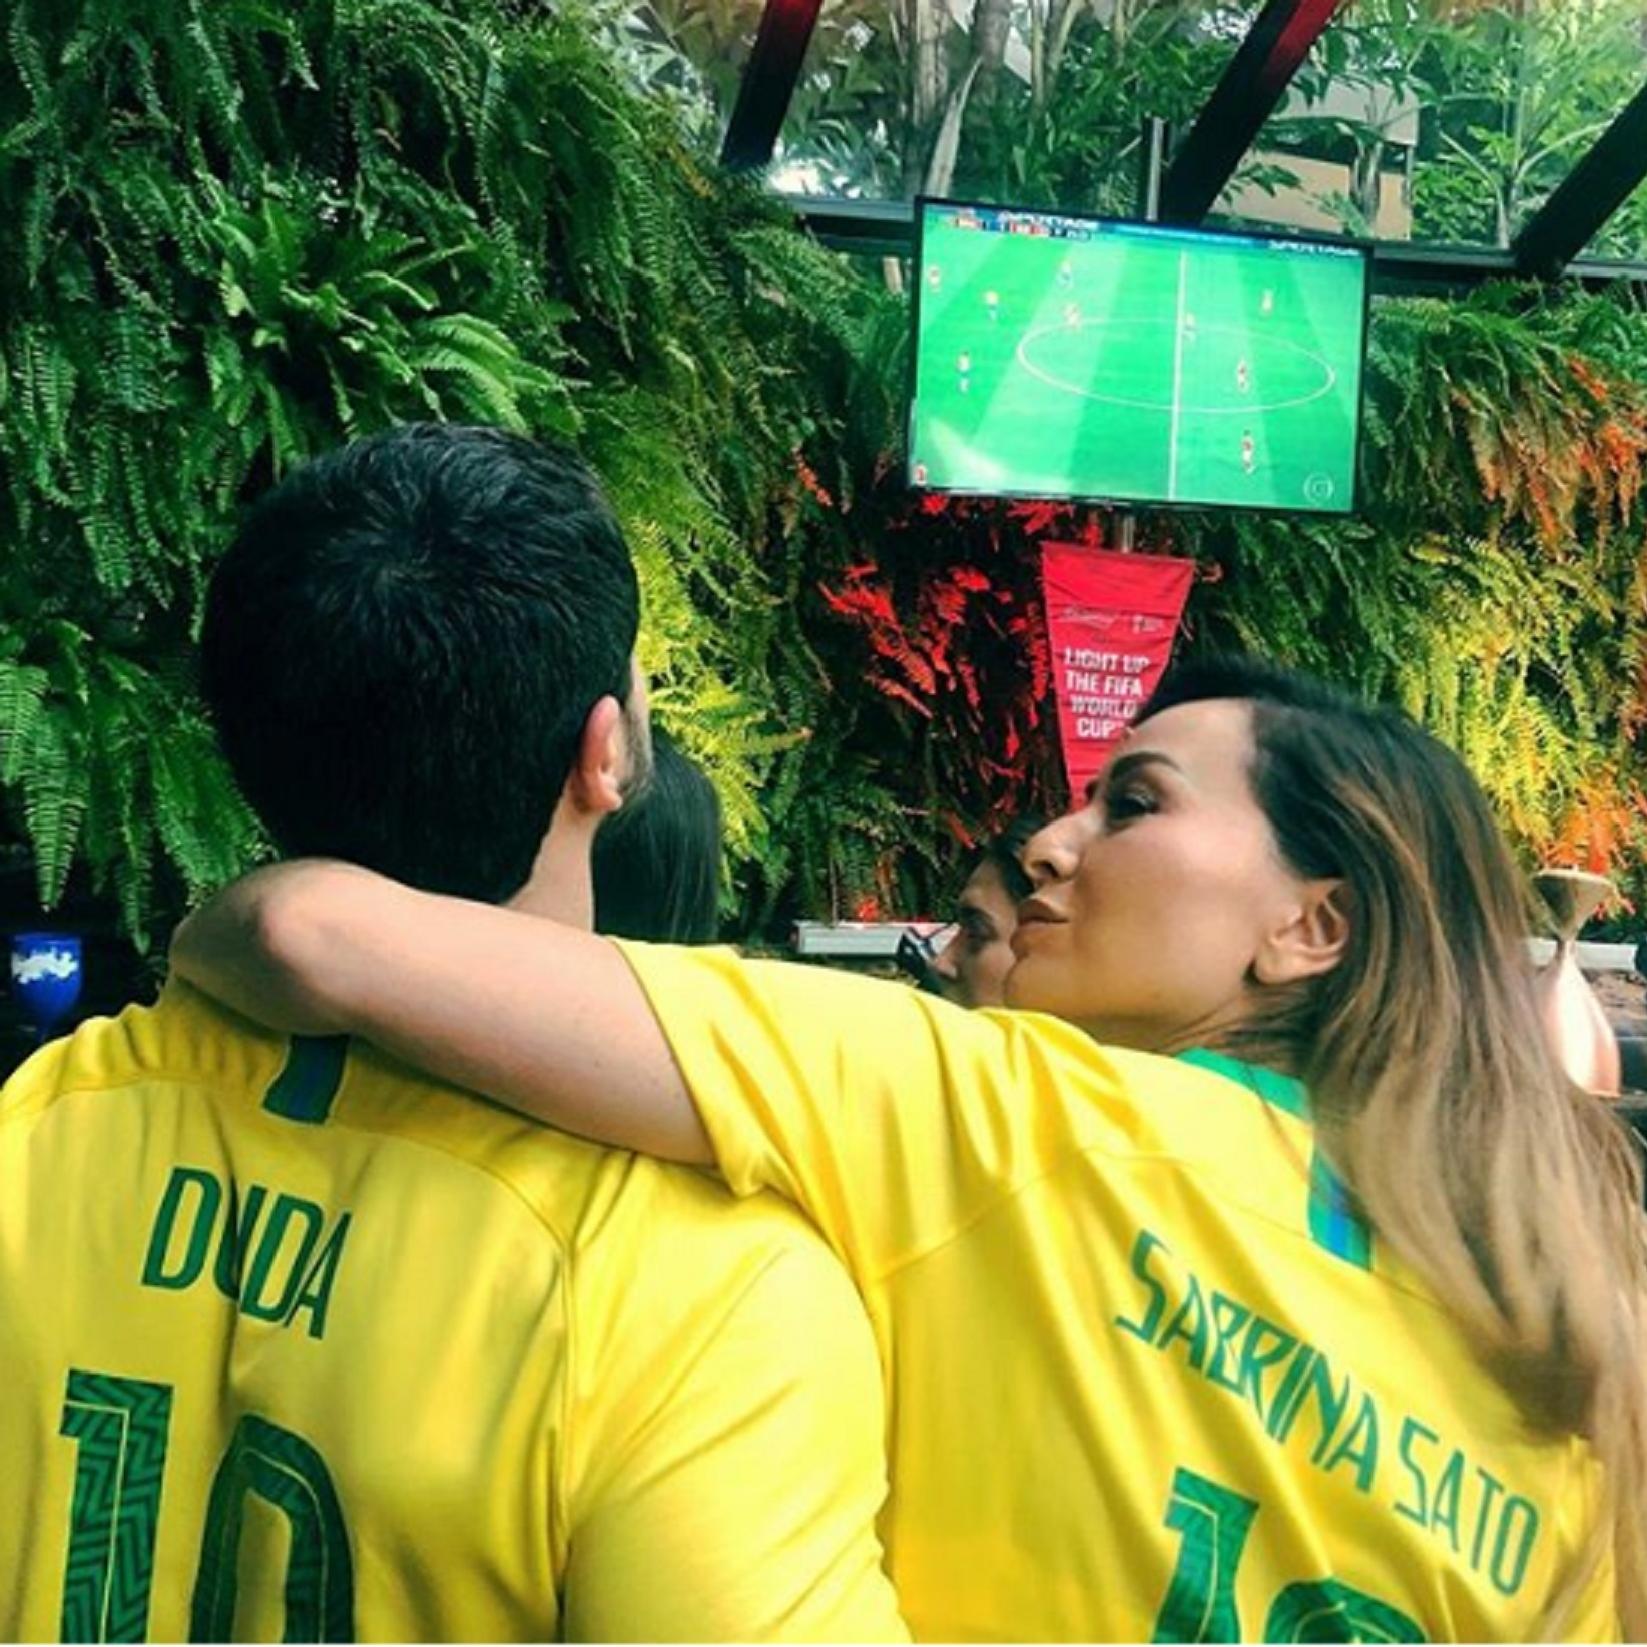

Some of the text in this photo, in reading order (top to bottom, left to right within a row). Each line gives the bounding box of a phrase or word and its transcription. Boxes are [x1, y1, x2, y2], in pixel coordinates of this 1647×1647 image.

[1064, 646, 1151, 673] LIGHT UP
[1066, 670, 1143, 697] THE FIFA
[1070, 694, 1137, 719] WORLD
[141, 1166, 352, 1340] DUDA
[1114, 1229, 1539, 1598] SABRINA SATO
[59, 1367, 356, 1644] 10
[1148, 1466, 1430, 1644] 1
